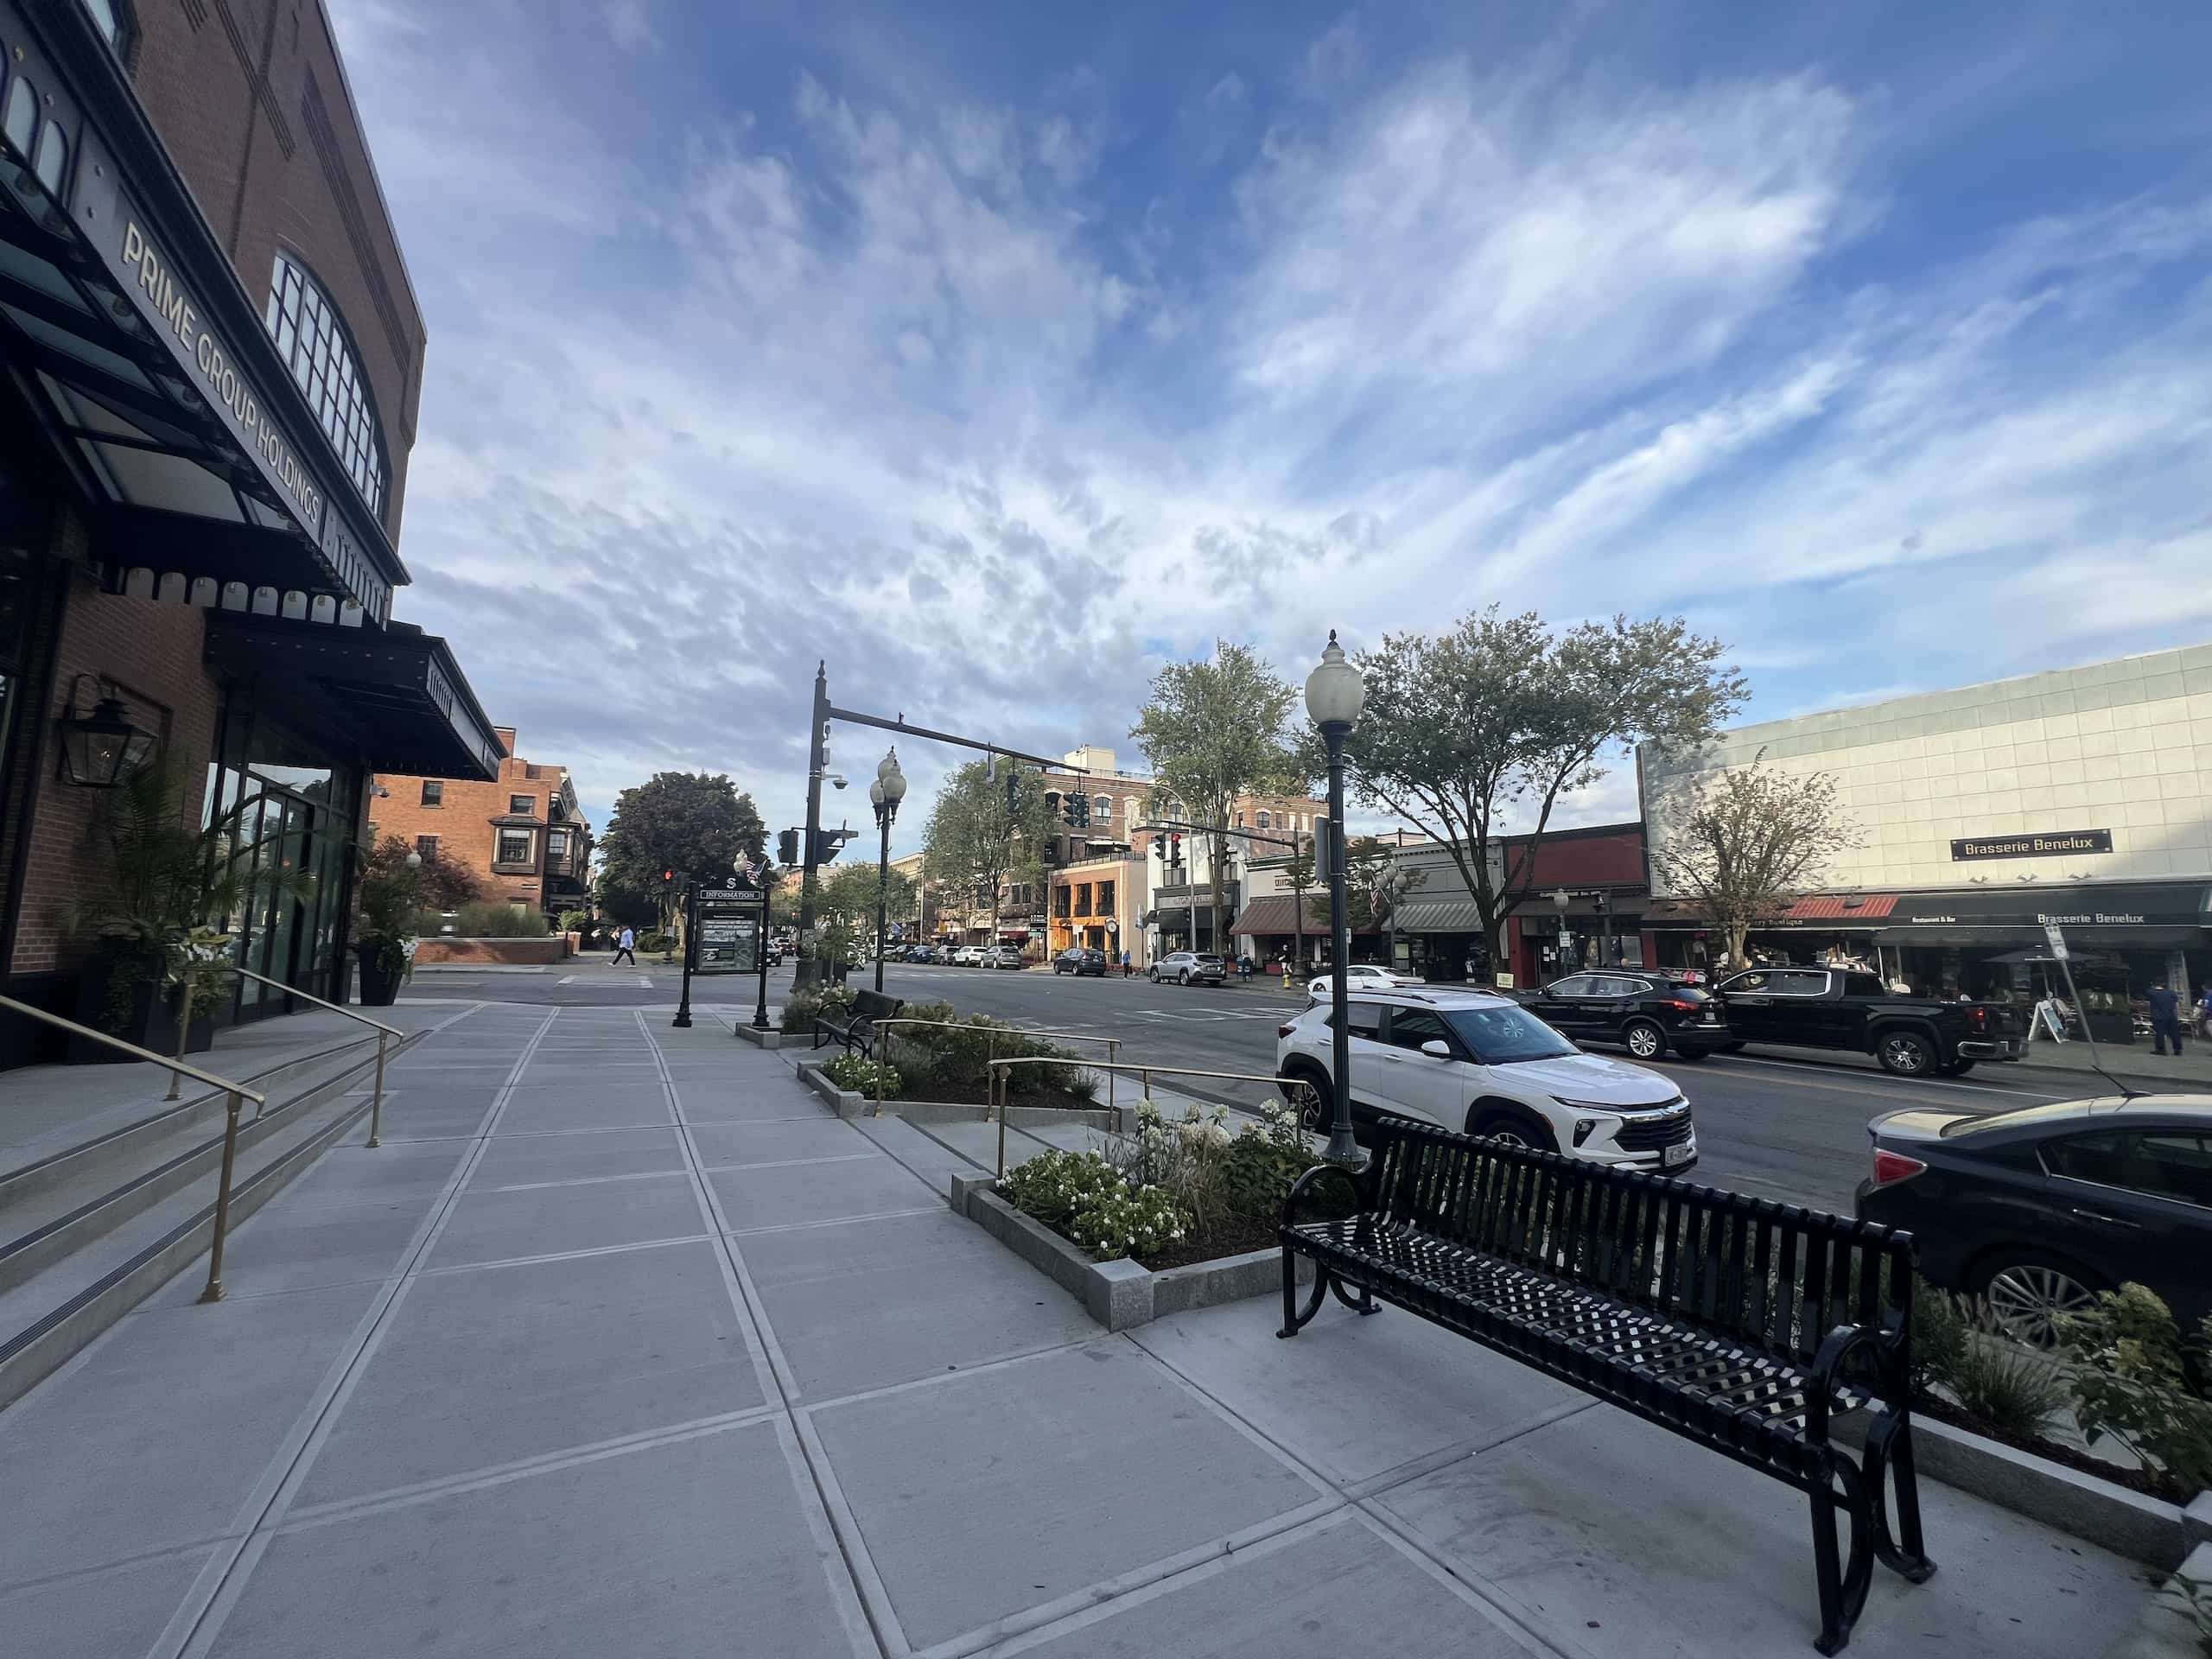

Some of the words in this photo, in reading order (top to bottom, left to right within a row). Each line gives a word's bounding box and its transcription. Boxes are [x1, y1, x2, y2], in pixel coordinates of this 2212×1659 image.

[122, 221, 196, 352] PRIME
[196, 333, 256, 431] GROUP
[257, 418, 320, 524] HOLDINGS
[1965, 841, 2030, 855] Brasserie
[2033, 836, 2094, 851] Benelux
[2037, 913, 2091, 924] Brasserie
[2095, 912, 2145, 924] Benelux
